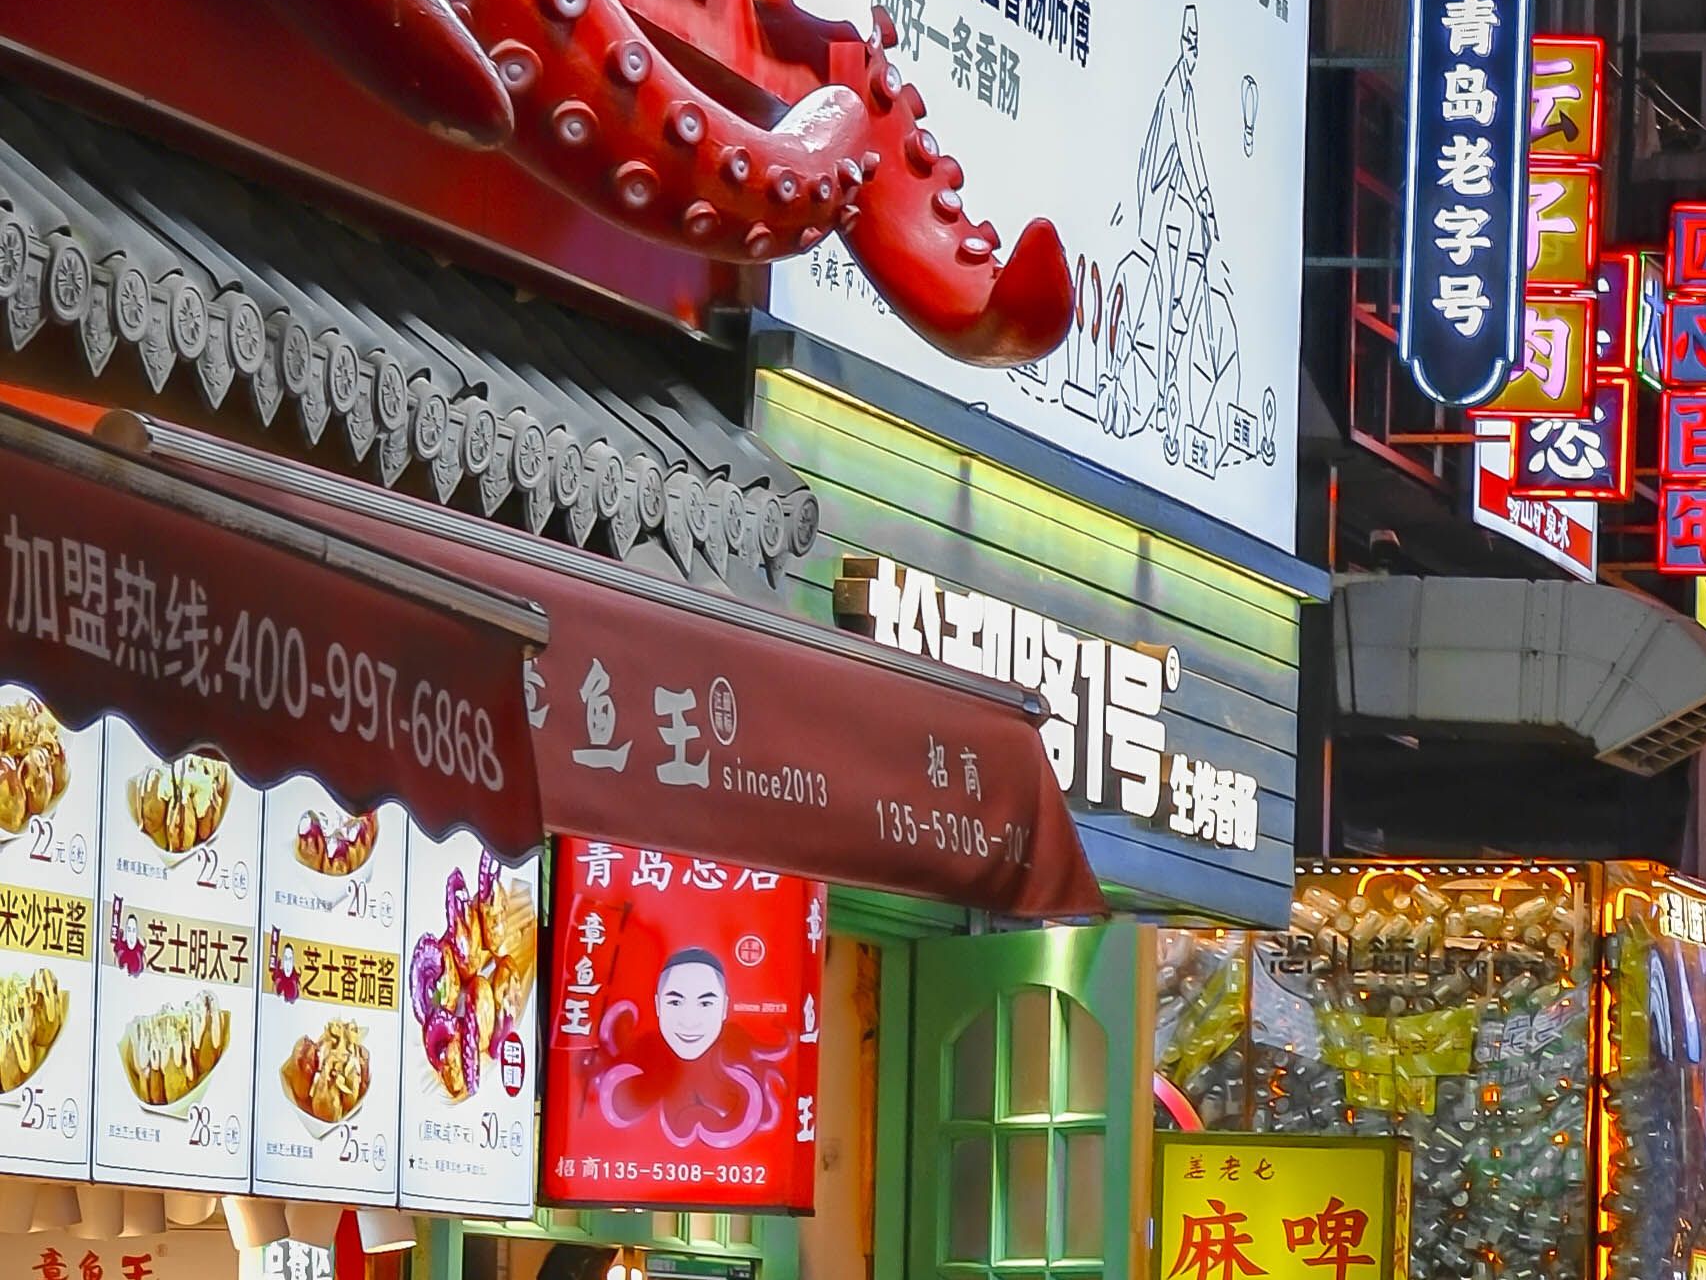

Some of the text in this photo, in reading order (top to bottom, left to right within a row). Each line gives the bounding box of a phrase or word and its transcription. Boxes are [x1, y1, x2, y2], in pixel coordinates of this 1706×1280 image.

[927, 732, 982, 803] 招商
[560, 912, 606, 1036] 章鱼王
[797, 897, 823, 1143] 章鱼王
